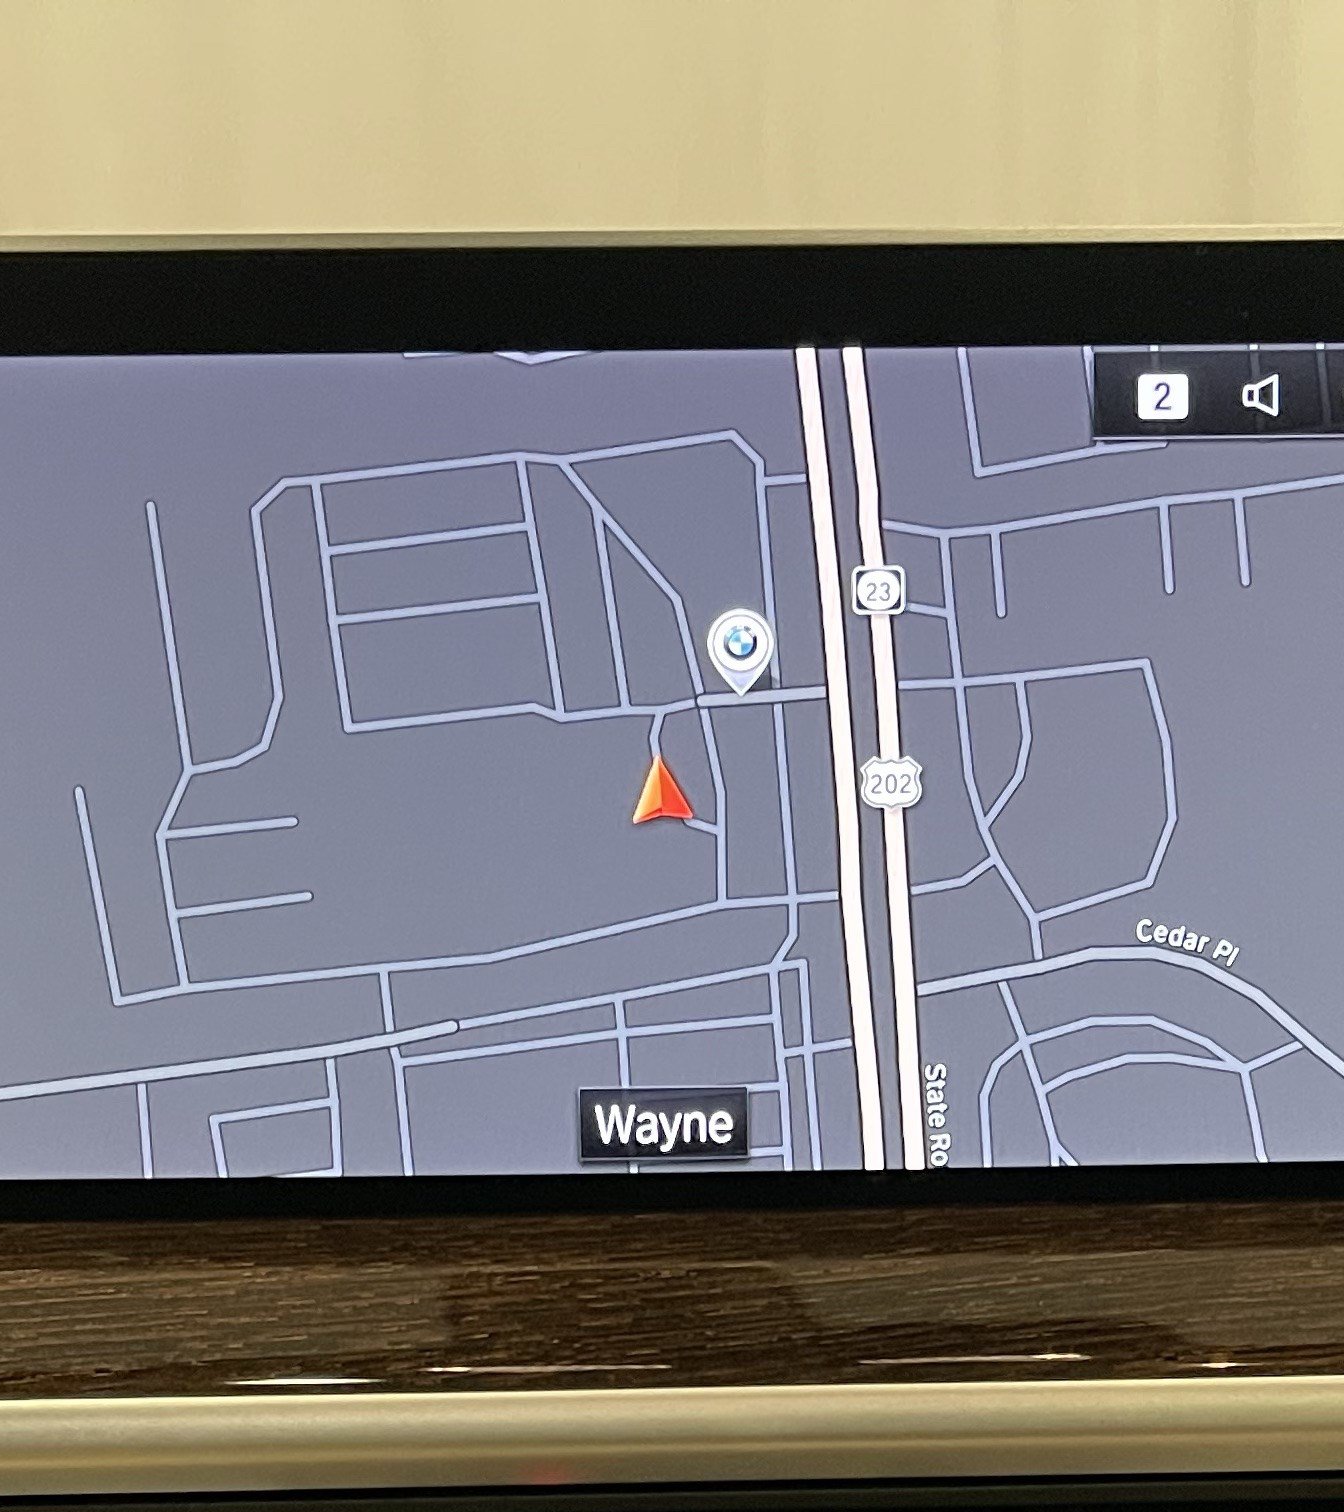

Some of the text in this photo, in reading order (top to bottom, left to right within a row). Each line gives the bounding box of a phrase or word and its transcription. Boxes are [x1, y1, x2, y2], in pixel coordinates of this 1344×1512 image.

[1154, 382, 1172, 411] 2
[866, 582, 891, 601] 23
[870, 774, 912, 794] 202
[1136, 918, 1240, 967] Cedar Pl
[924, 1063, 948, 1128] State
[594, 1103, 735, 1153] Wayne
